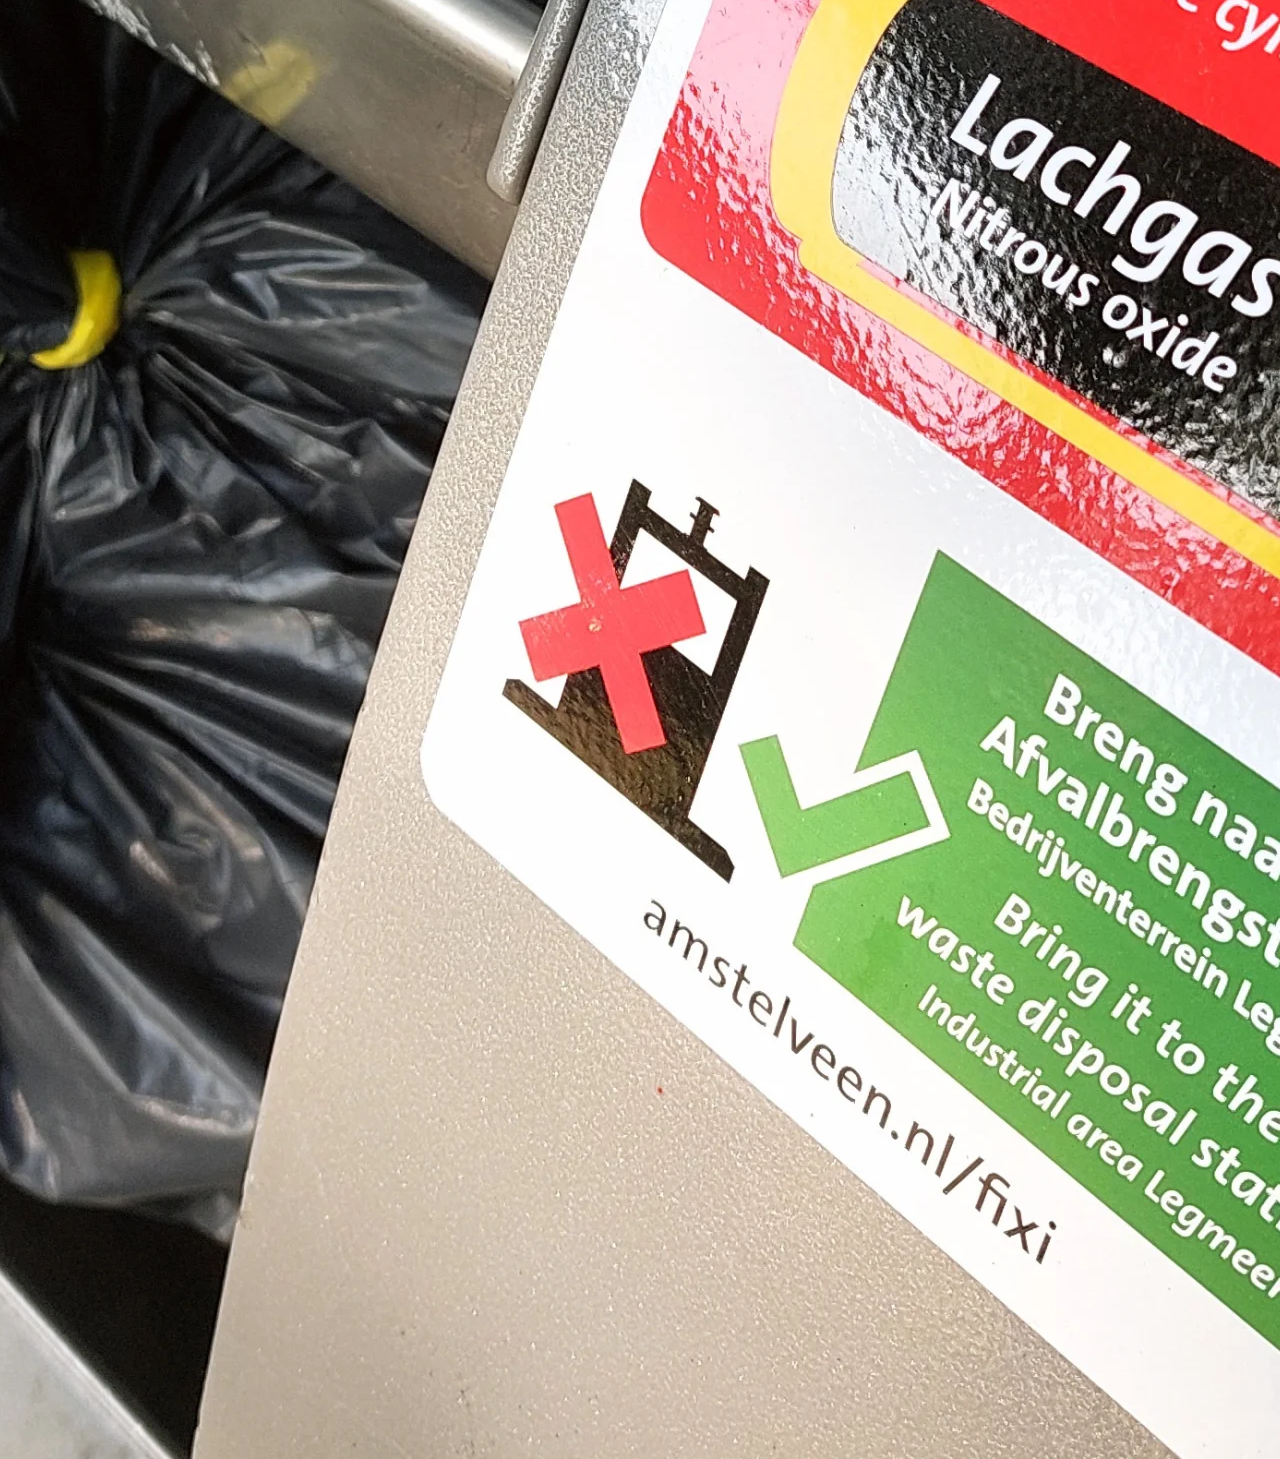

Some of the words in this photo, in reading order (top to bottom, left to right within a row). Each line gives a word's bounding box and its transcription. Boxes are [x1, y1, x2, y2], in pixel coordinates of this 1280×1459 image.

[930, 176, 1100, 308] Nitrous
[1100, 293, 1239, 394] oxide
[1042, 673, 1189, 817] Breng
[966, 777, 1231, 998] Bedrijventerrein
[992, 893, 1112, 1009] Bring
[1110, 983, 1155, 1036] it
[1160, 1017, 1207, 1077] to
[642, 897, 1059, 1266] amstelveen.nl/fixi
[894, 894, 1017, 1006] waste
[1017, 989, 1198, 1146] disposal
[917, 984, 1072, 1121] Industrial
[1066, 1112, 1145, 1183] area
